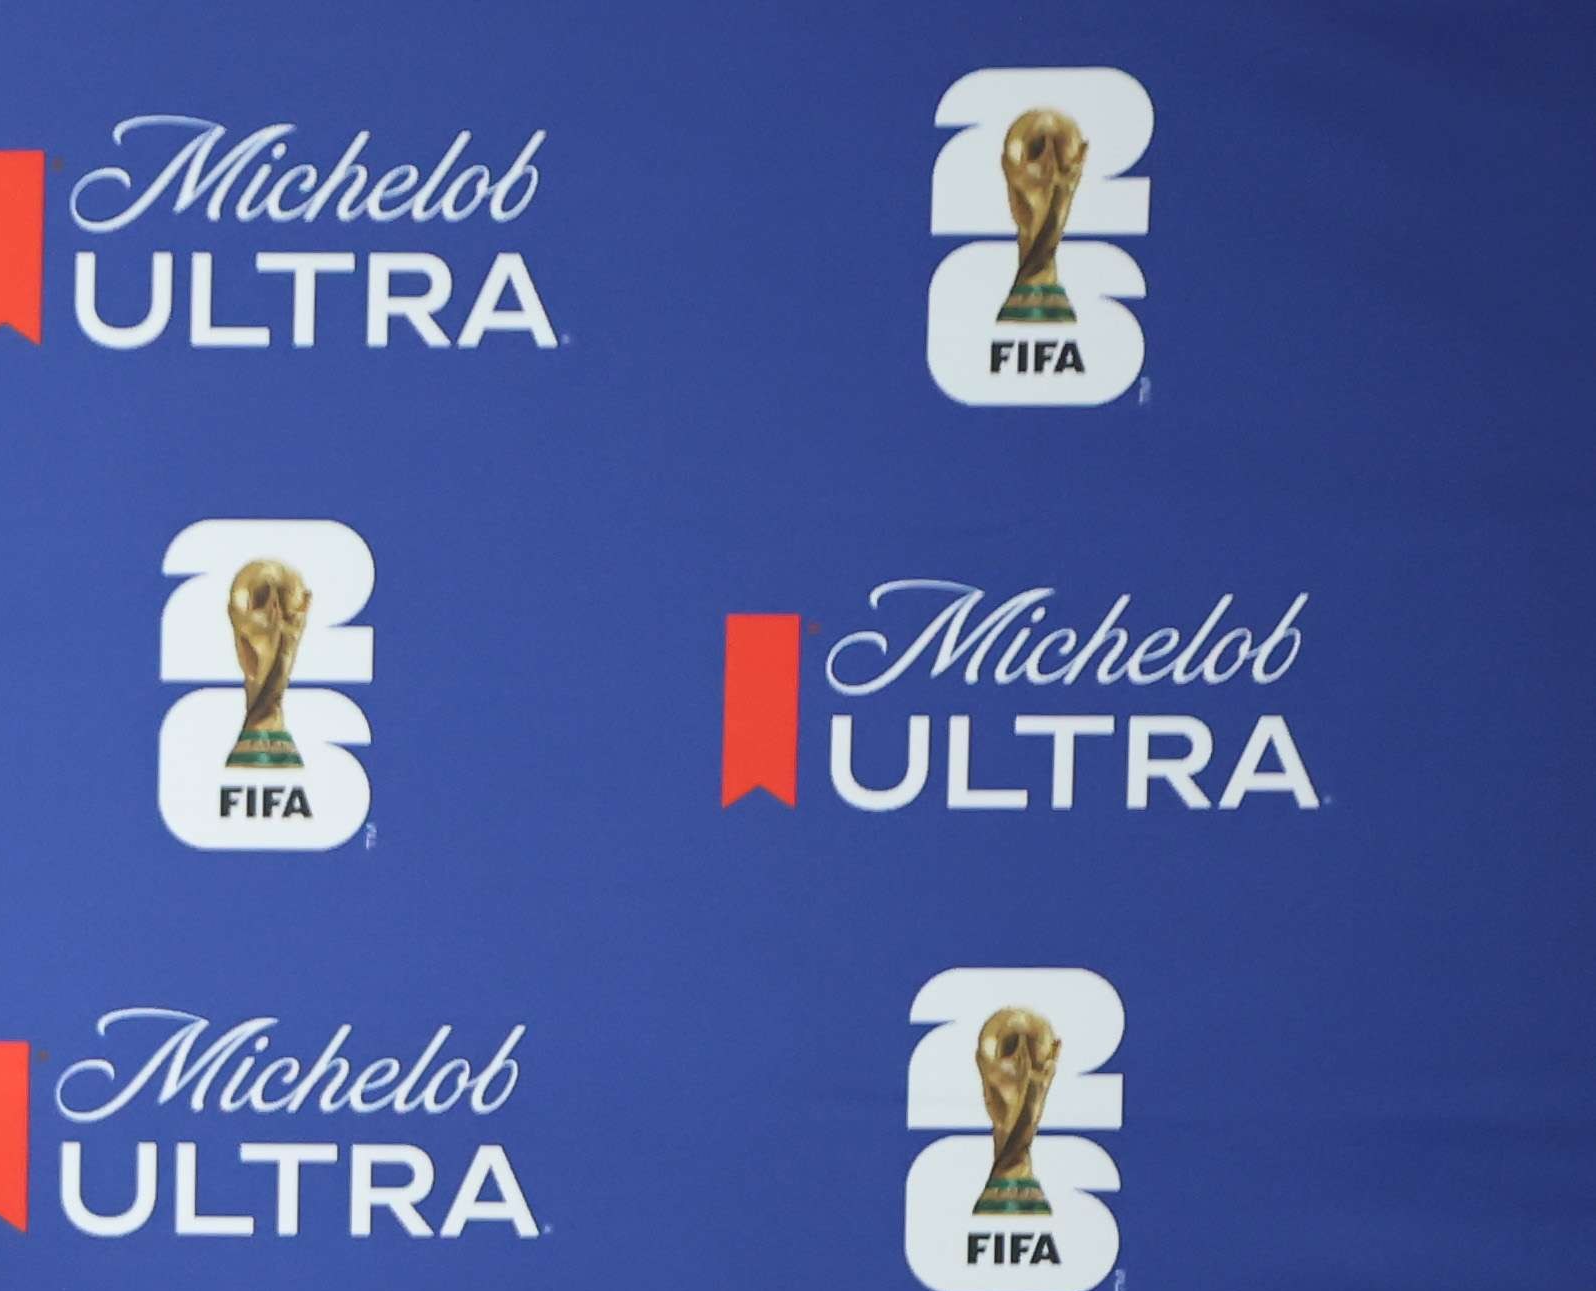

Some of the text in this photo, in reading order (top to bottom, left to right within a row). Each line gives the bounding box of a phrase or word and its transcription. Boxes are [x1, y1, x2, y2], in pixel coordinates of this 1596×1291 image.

[70, 116, 545, 232] Michelob
[75, 252, 557, 349] ULTRA
[991, 342, 1084, 372] FIFA
[826, 580, 1308, 695] Michelob
[221, 788, 311, 817] FIFA
[831, 715, 1319, 812] ULTRA
[56, 1008, 525, 1122] Michelob
[61, 1142, 539, 1237] ULTRA
[968, 1235, 1059, 1264] FIFA
